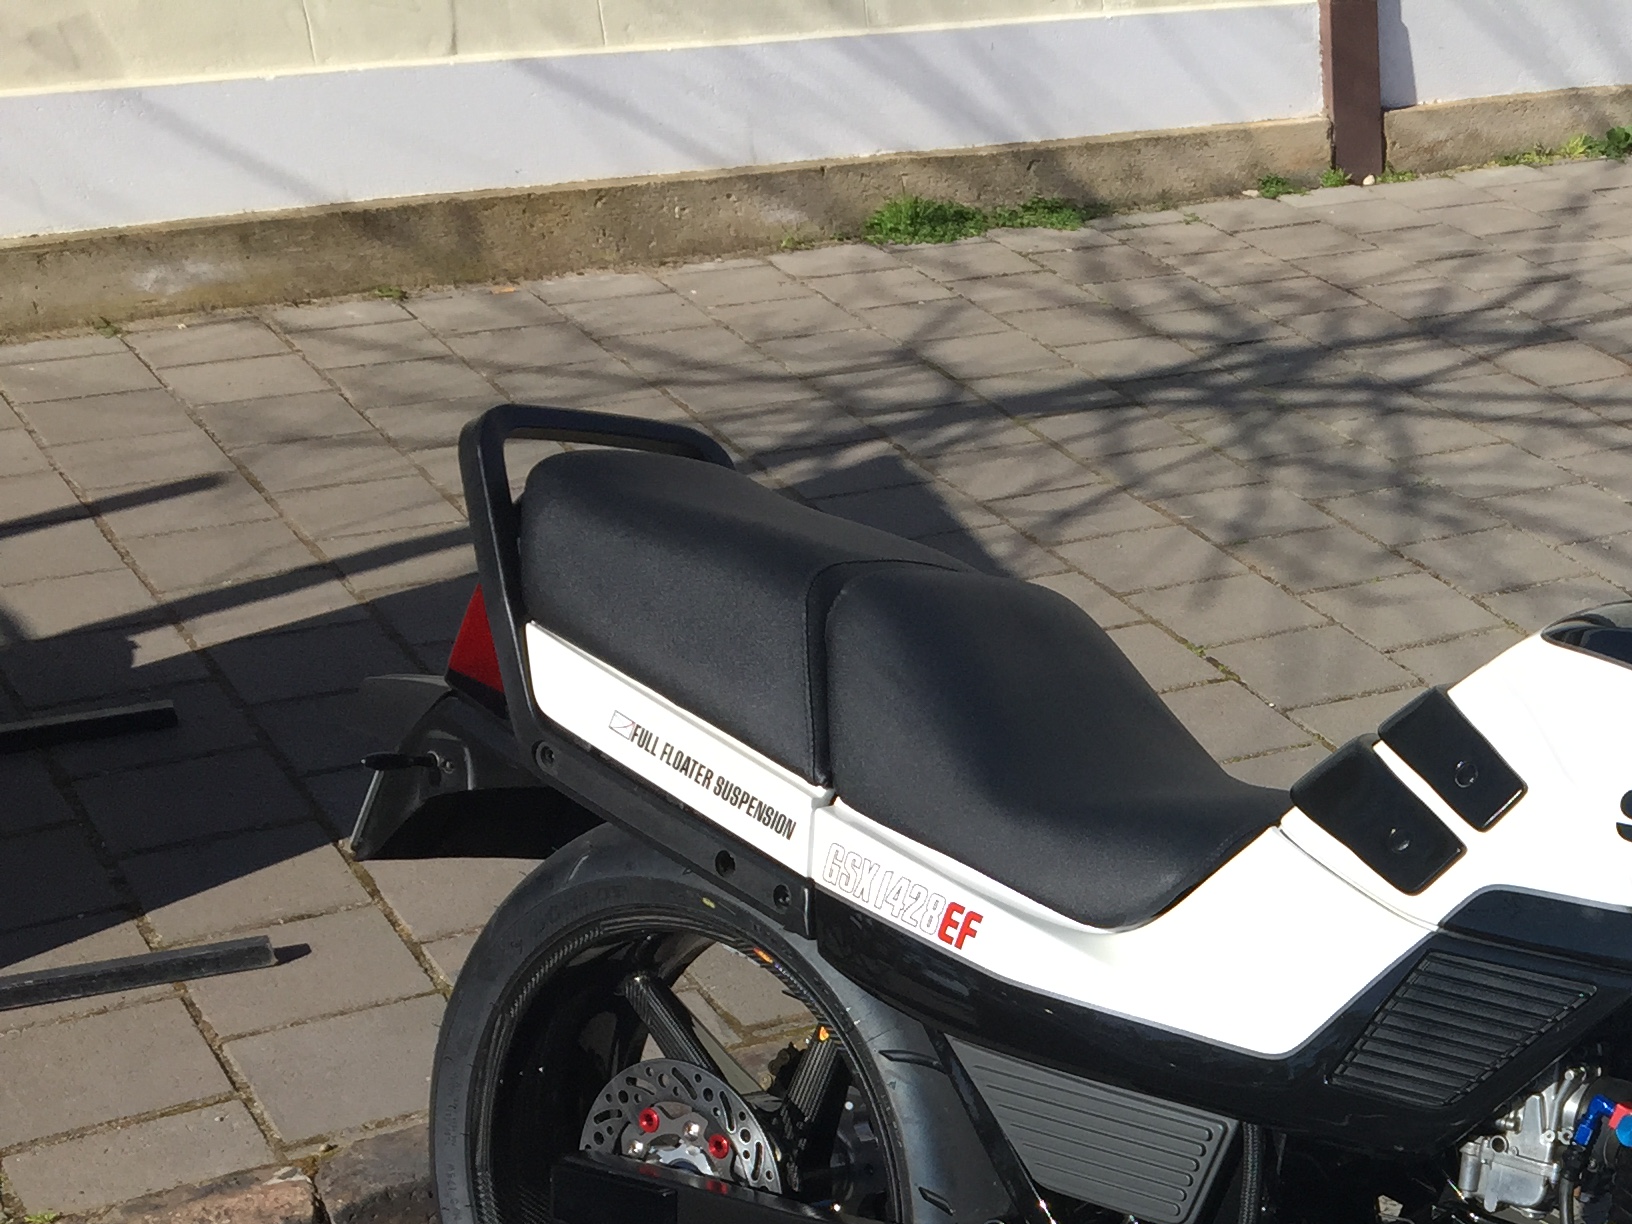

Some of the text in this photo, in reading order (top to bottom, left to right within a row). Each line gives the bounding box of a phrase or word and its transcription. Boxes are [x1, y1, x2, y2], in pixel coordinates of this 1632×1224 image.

[631, 723, 797, 841] FULL FLOATER SUSPENSION
